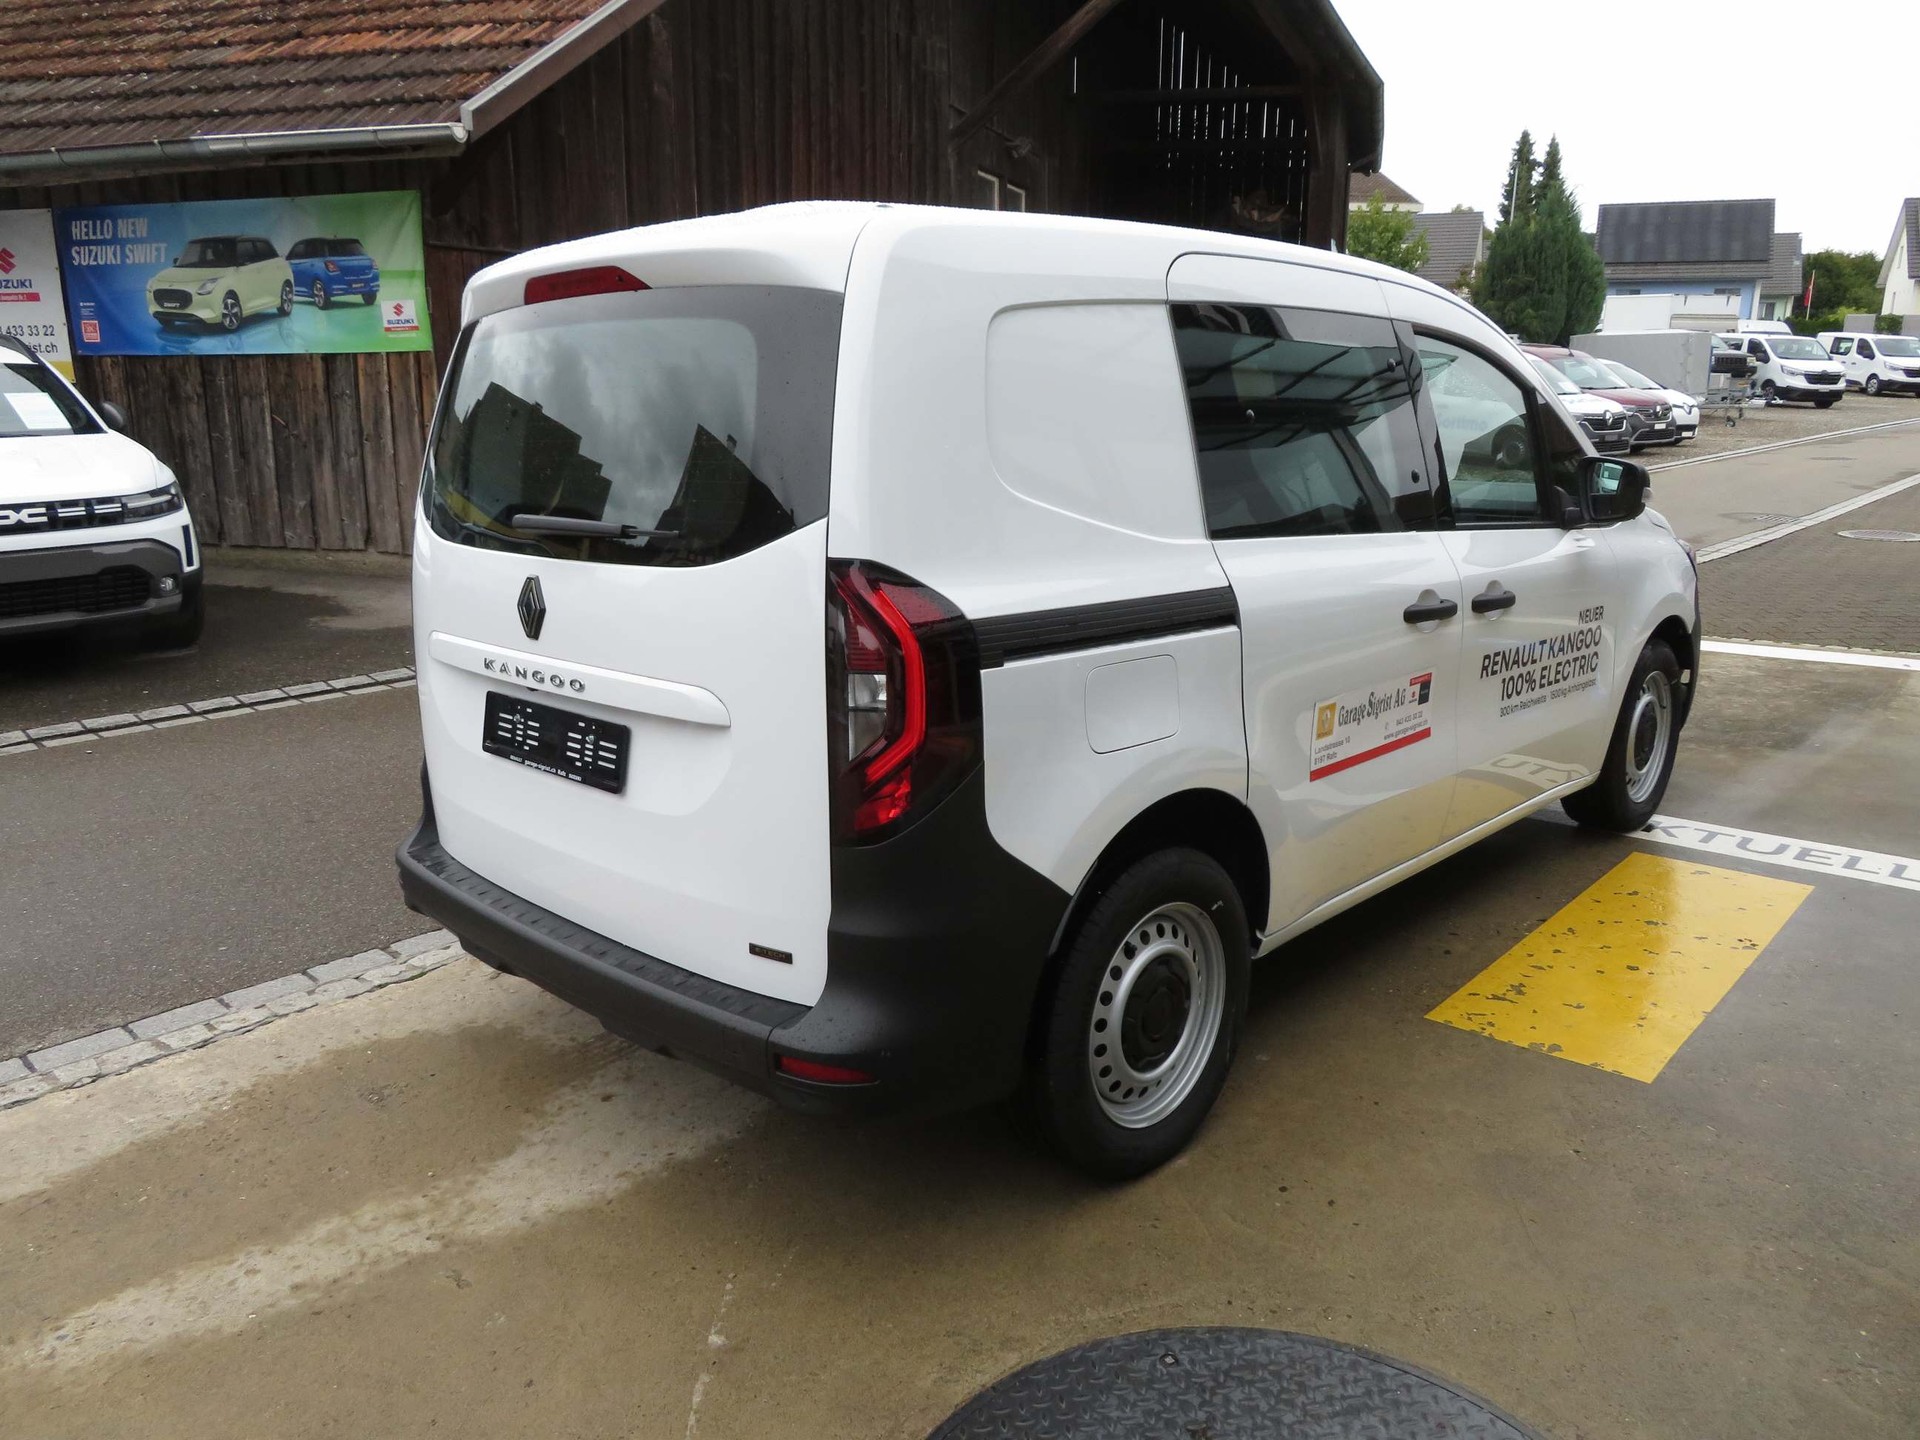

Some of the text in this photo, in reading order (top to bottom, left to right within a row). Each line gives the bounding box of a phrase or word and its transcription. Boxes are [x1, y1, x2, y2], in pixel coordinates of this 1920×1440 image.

[71, 217, 148, 240] HELLO NEW
[71, 243, 168, 266] SUZUKI SWIFT
[27, 325, 40, 337] 33
[42, 325, 55, 337] 22
[1578, 605, 1604, 625] NEUER
[1480, 625, 1602, 680] RENAULT KANGOO
[484, 657, 586, 693] KANGOO
[1501, 651, 1599, 701] 100% ELECTRIC
[1338, 688, 1407, 727] Garage Sigrist AG
